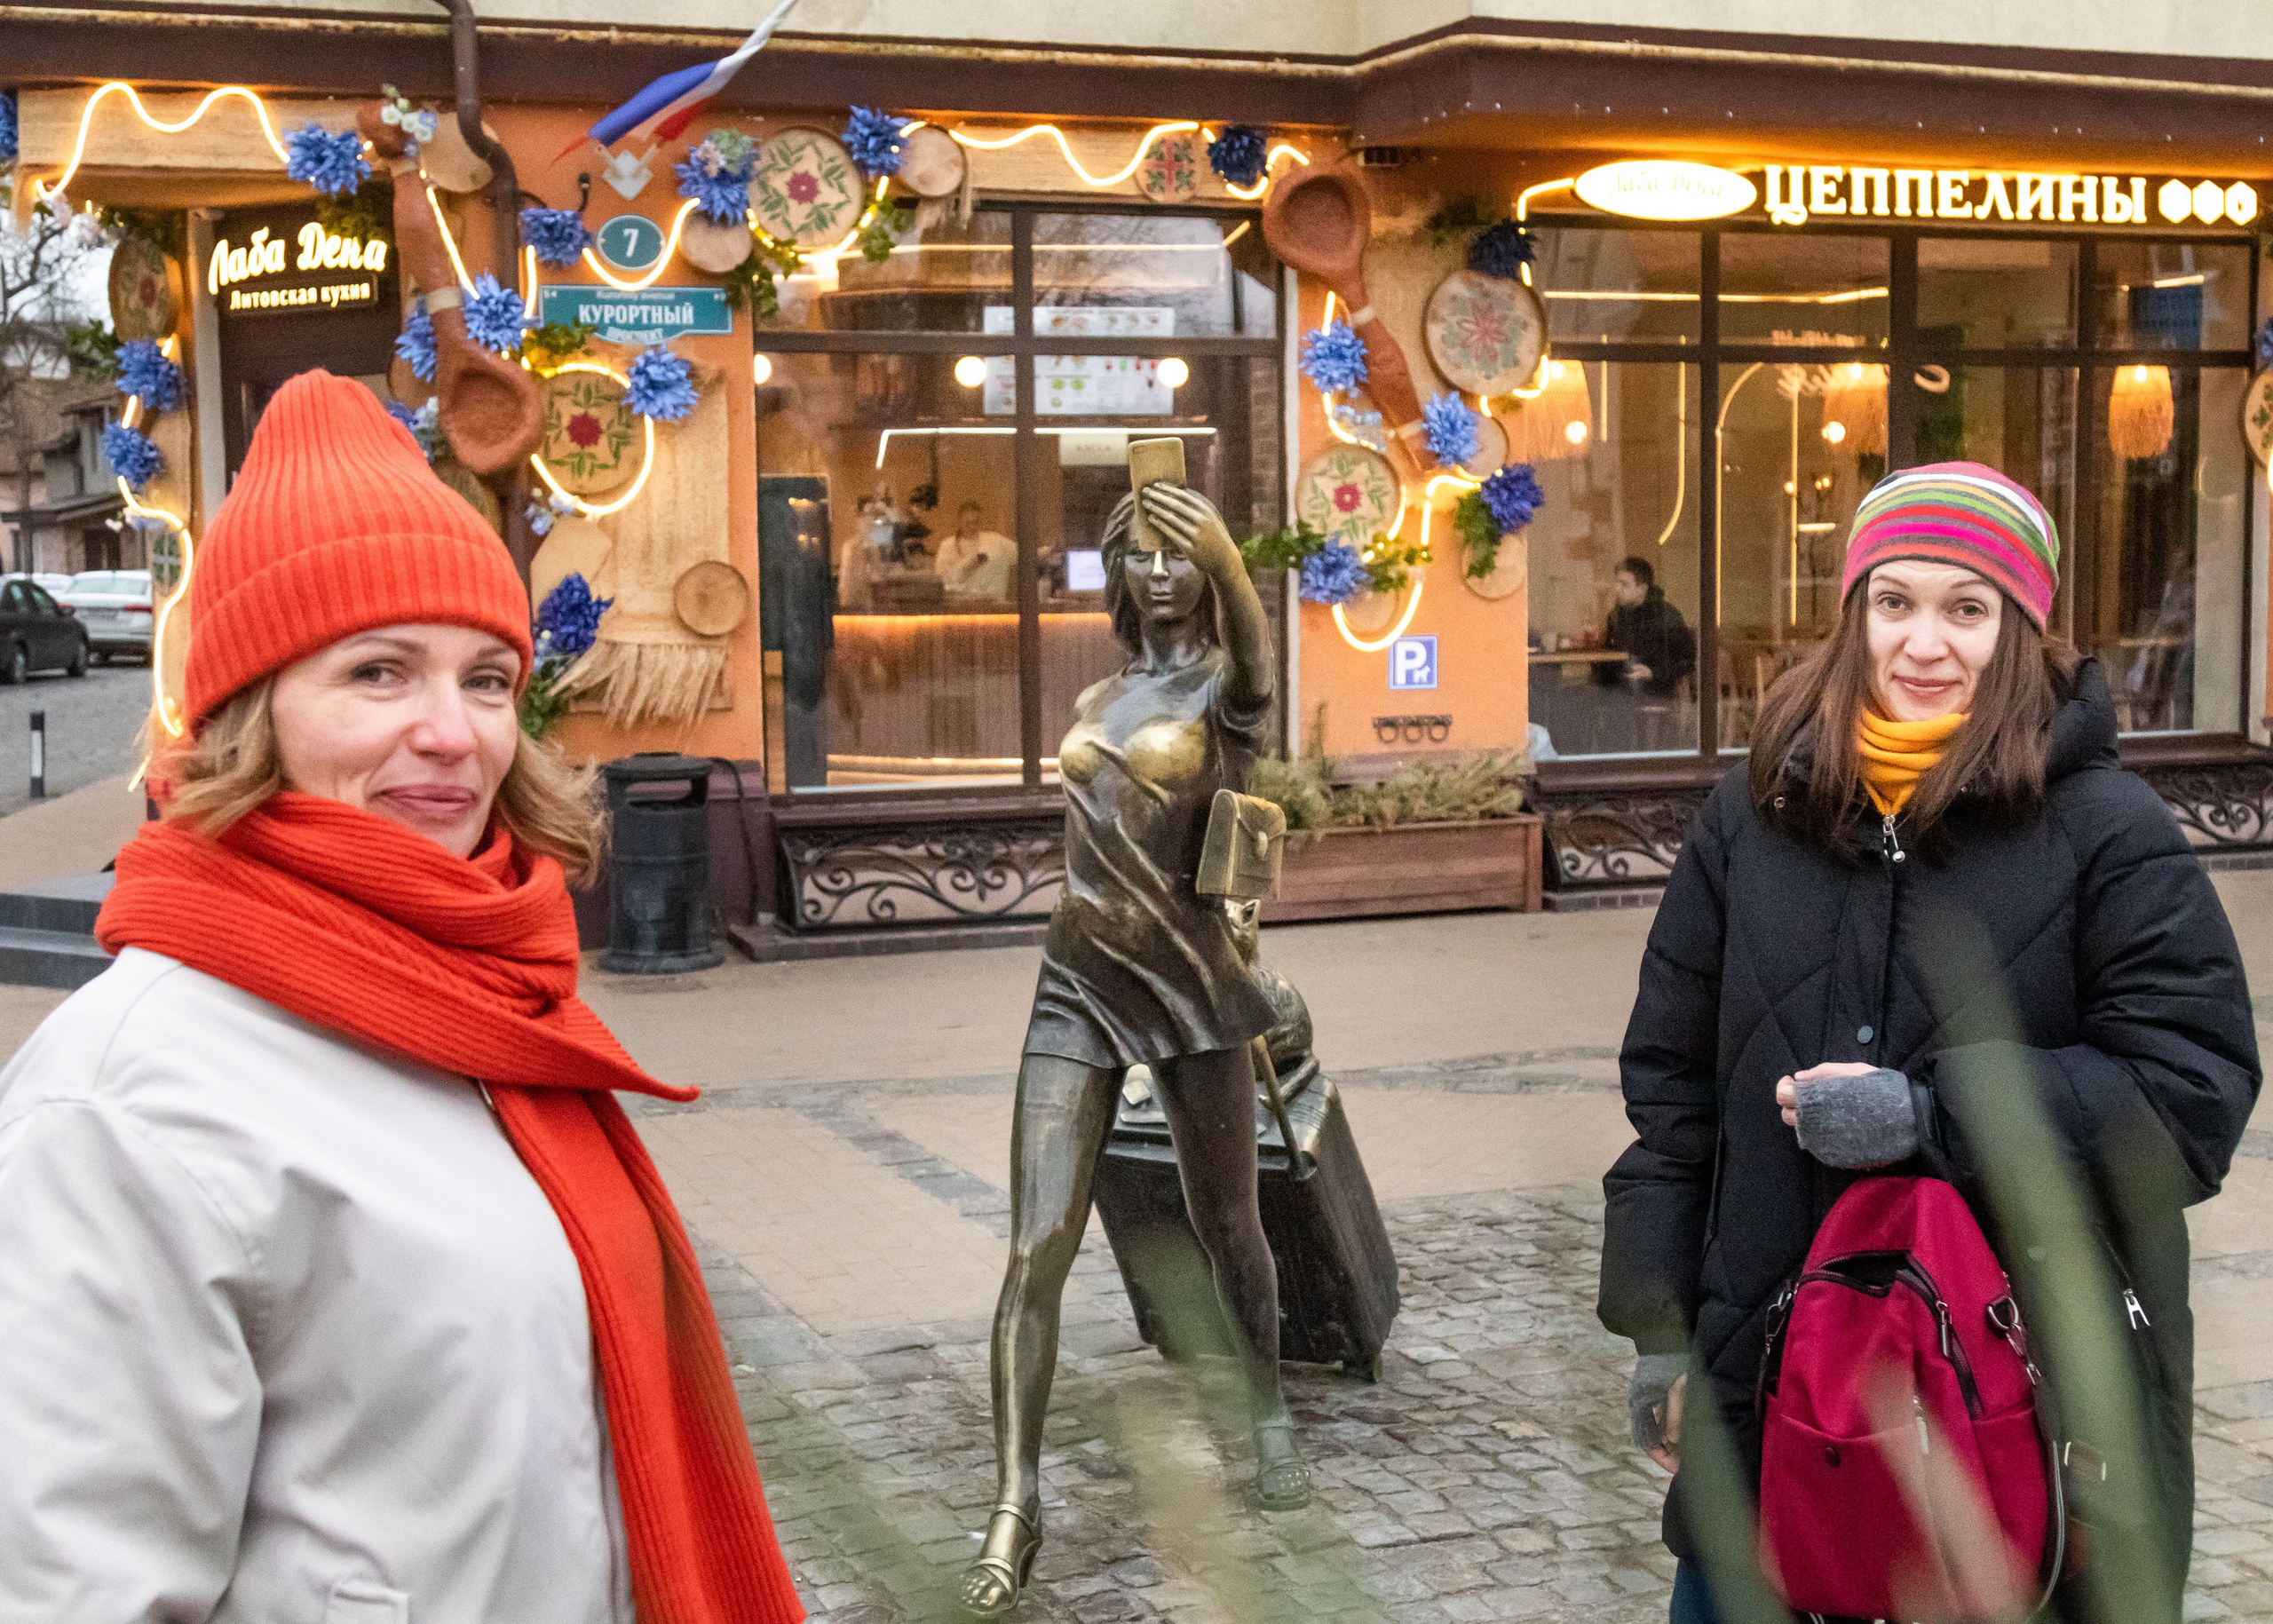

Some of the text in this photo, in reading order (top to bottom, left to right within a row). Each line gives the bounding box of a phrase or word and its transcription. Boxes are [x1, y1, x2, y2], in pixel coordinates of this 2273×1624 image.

[1764, 164, 2148, 226] ЦЕППЕЛИНЫ
[208, 226, 286, 296] Лаба
[623, 228, 639, 257] 7
[230, 282, 370, 310] Литовская кухня
[578, 302, 694, 325] КУРОРТНЫЙ
[1395, 640, 1427, 685] P
